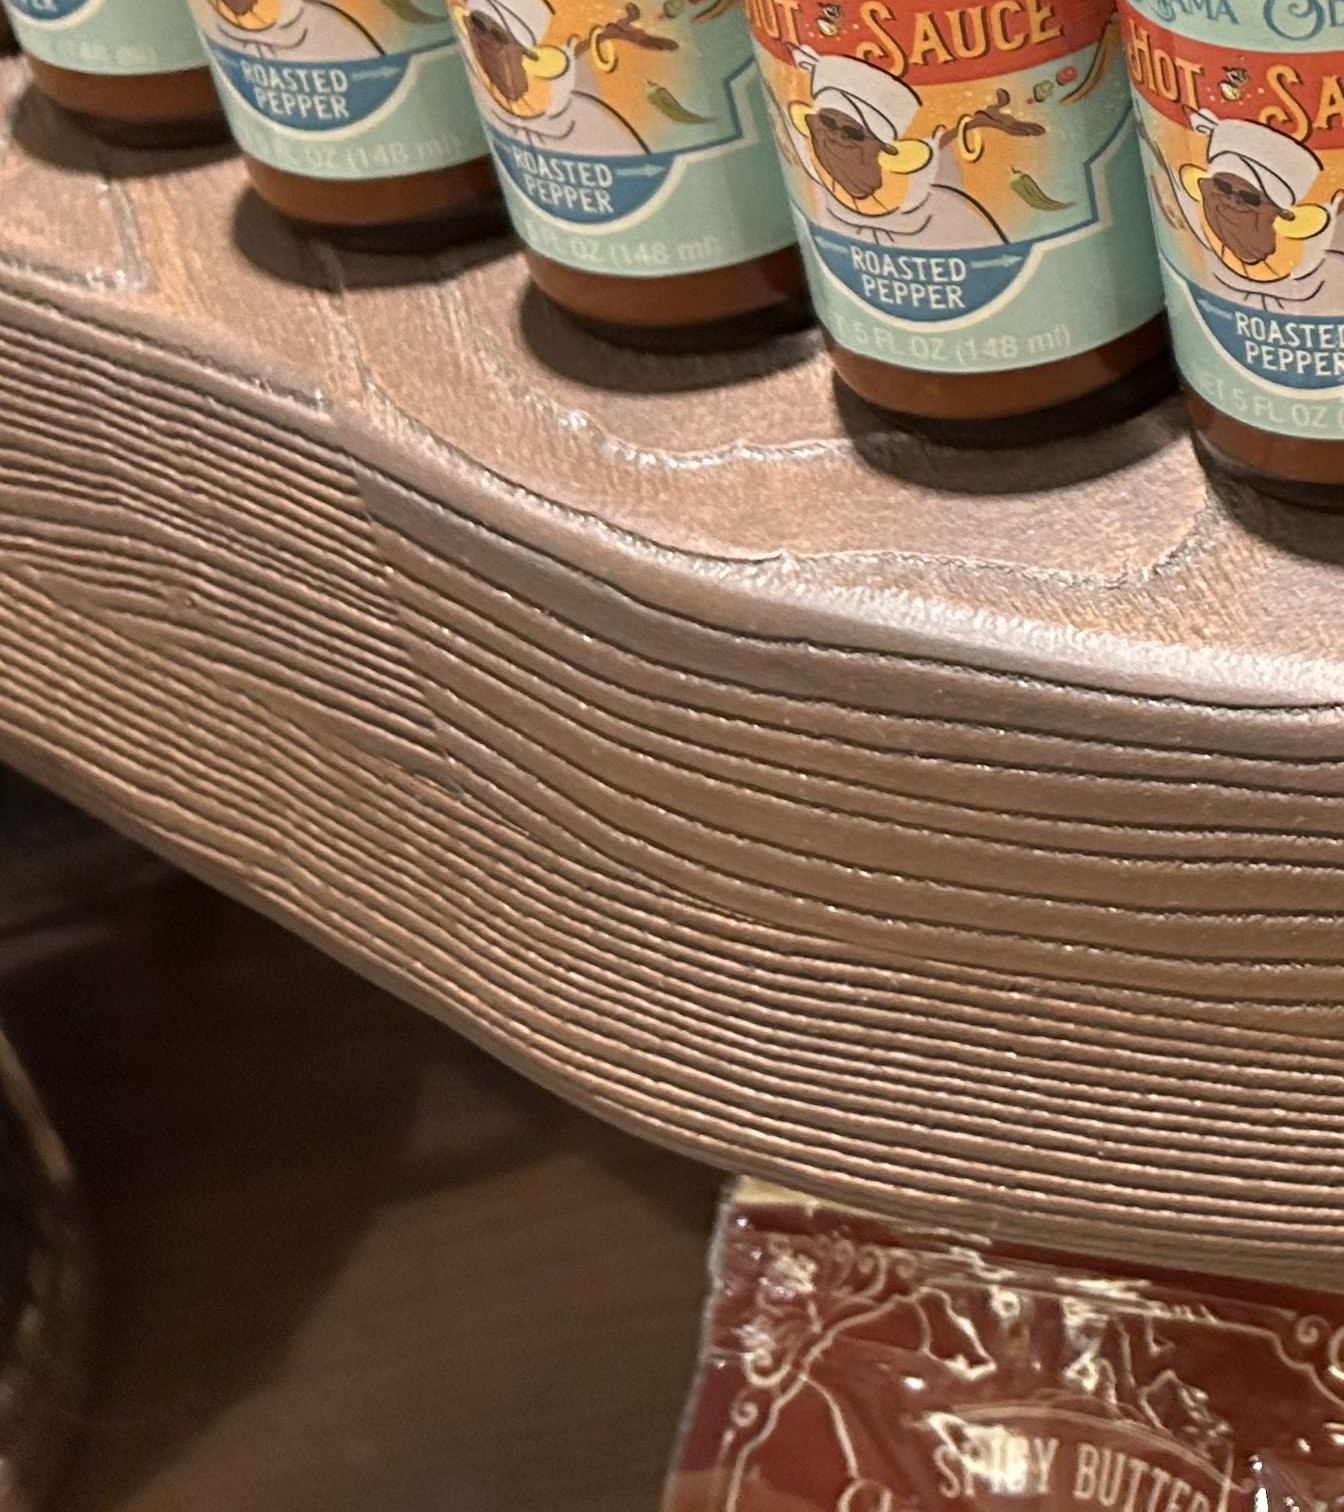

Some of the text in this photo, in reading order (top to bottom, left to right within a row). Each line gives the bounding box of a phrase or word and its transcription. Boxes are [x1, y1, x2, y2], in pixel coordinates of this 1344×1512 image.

[239, 59, 349, 93] ROASTED
[1126, 16, 1206, 112] HOT
[252, 87, 350, 120] PEPPER
[511, 145, 613, 187] ROASTED
[524, 175, 614, 214] PEPPER
[850, 244, 967, 283] ROASTED
[860, 274, 967, 310] PEPPER
[910, 334, 946, 363] OZ
[1232, 388, 1249, 413] 5
[1252, 397, 1285, 424] FL
[1291, 403, 1330, 429] OZ
[932, 1430, 1061, 1498] SIY
